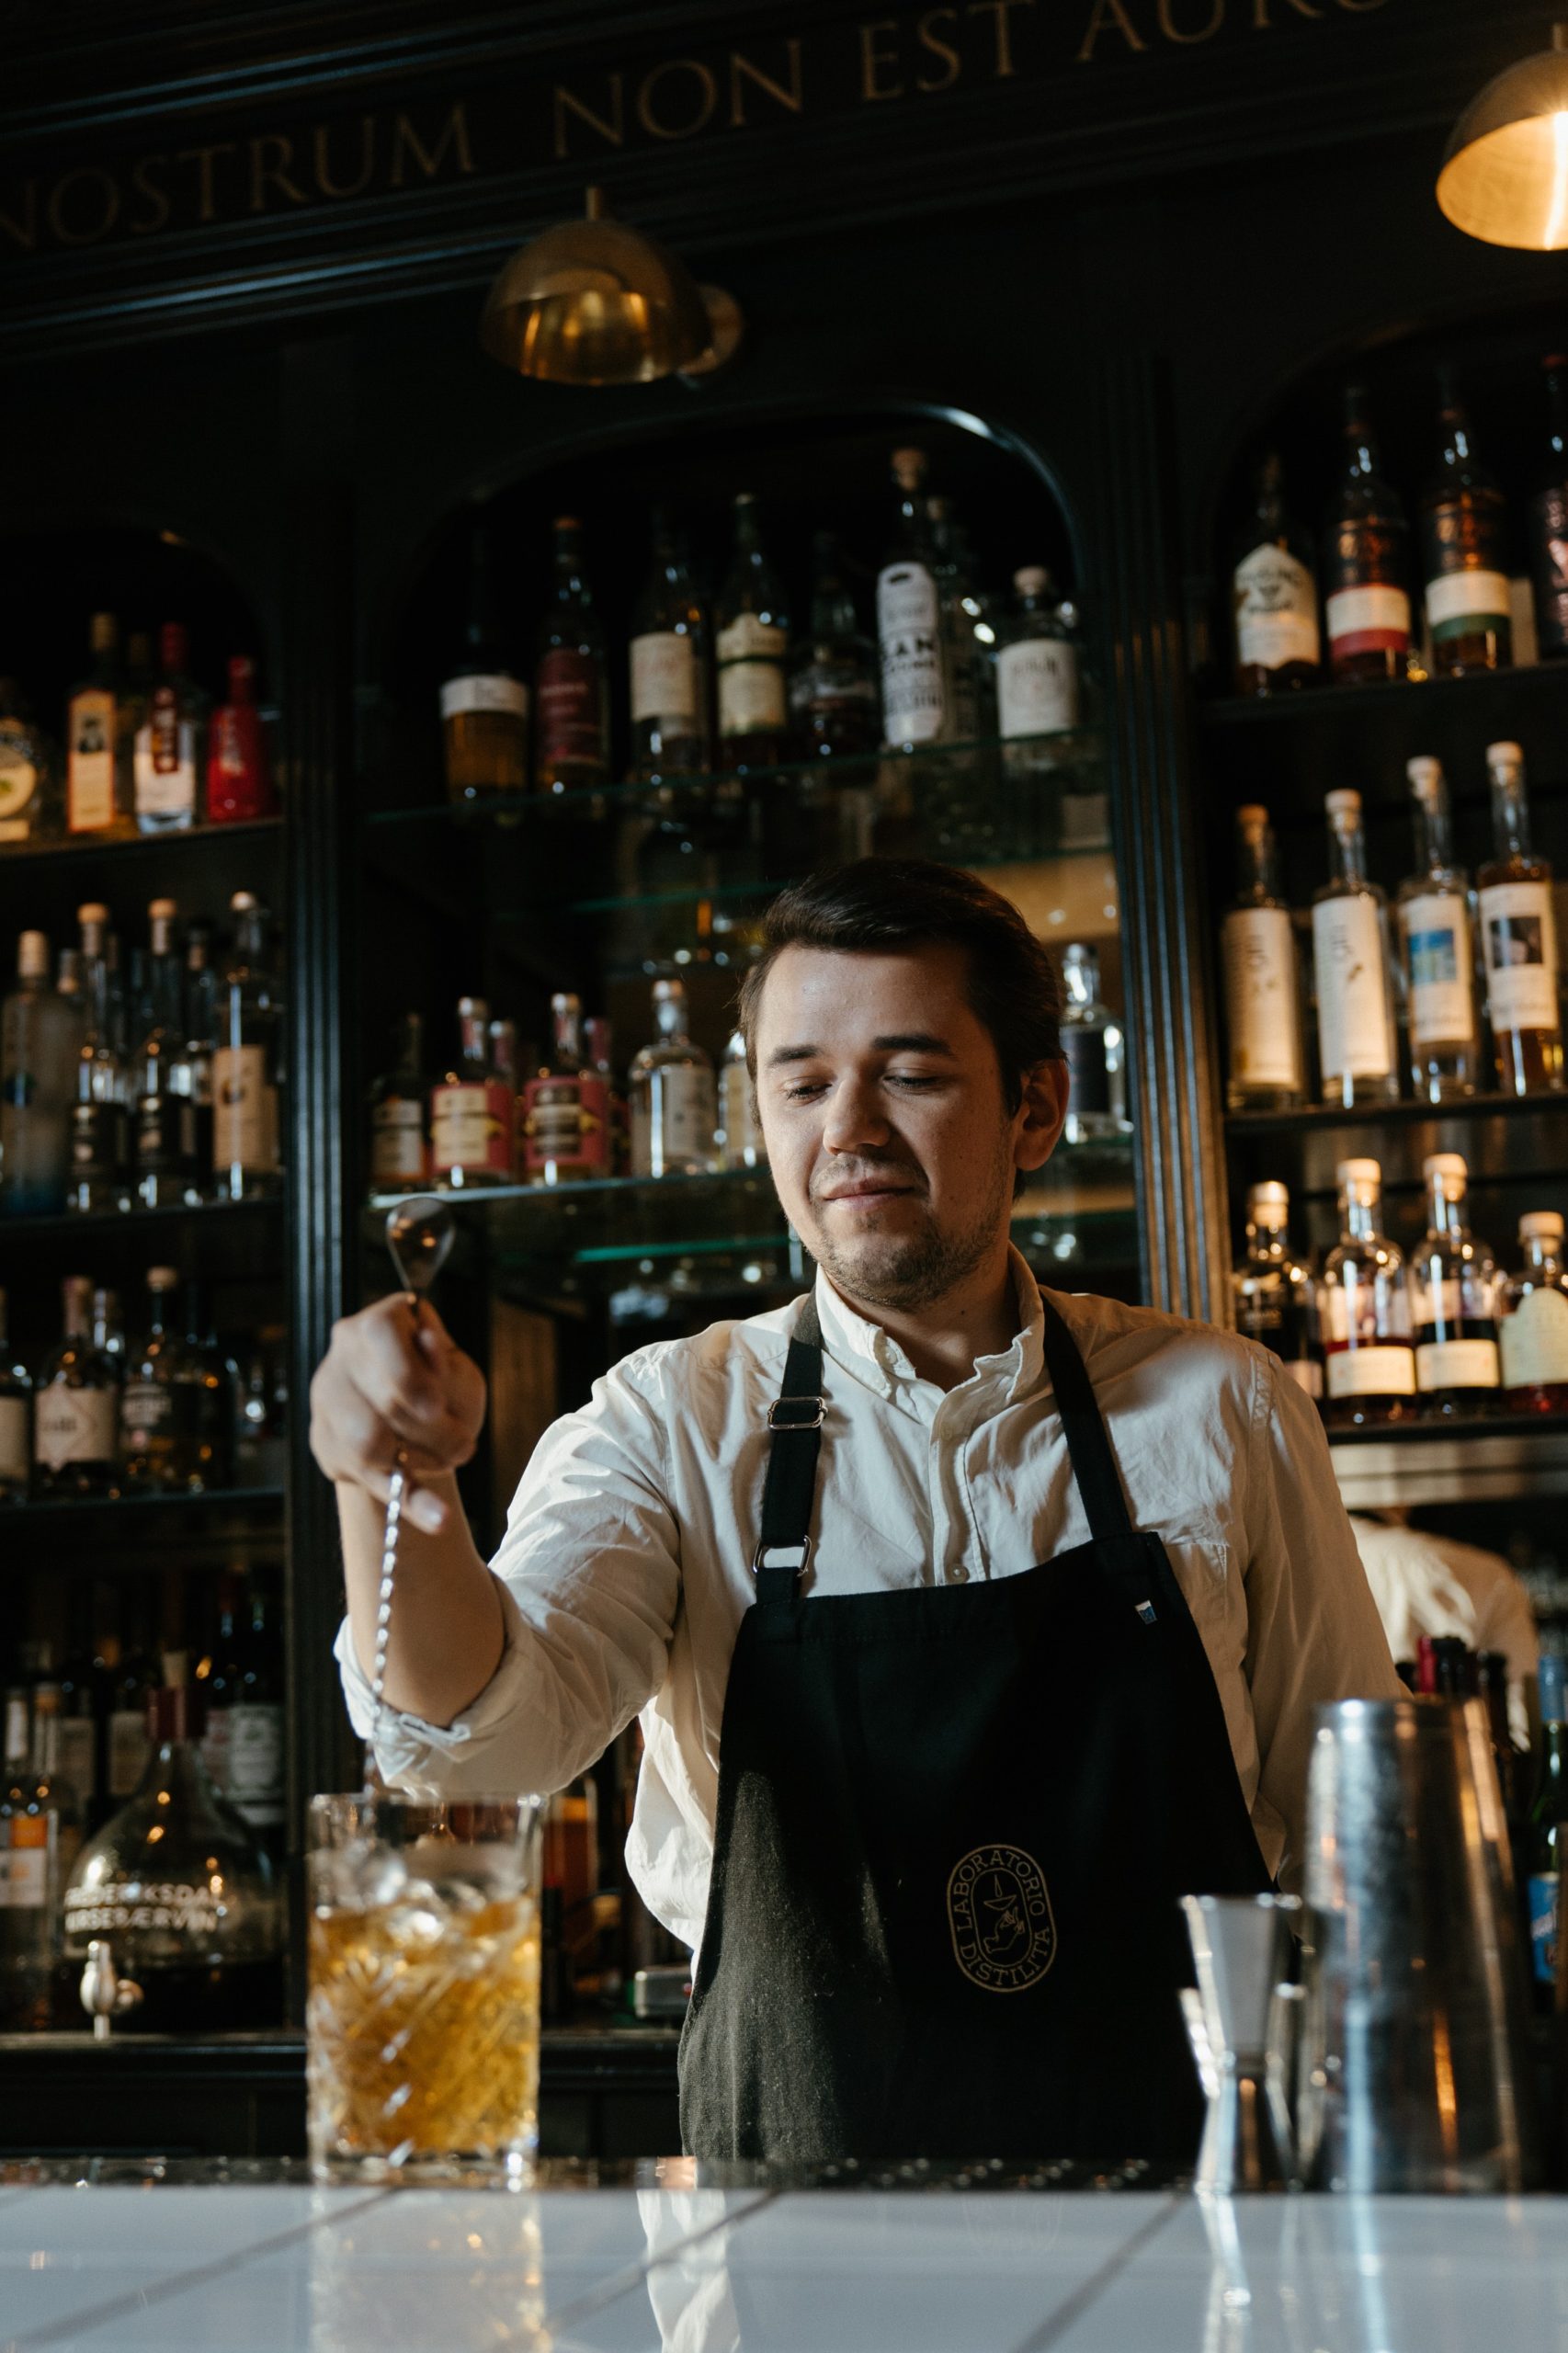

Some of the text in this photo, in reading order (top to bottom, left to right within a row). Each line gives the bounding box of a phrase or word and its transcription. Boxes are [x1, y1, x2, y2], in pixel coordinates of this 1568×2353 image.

[0, 0, 1385, 250] NOSTRUM NON EST AU
[953, 1849, 1046, 1932] LABORATORIO
[960, 1927, 1050, 1985] DISTILITA
